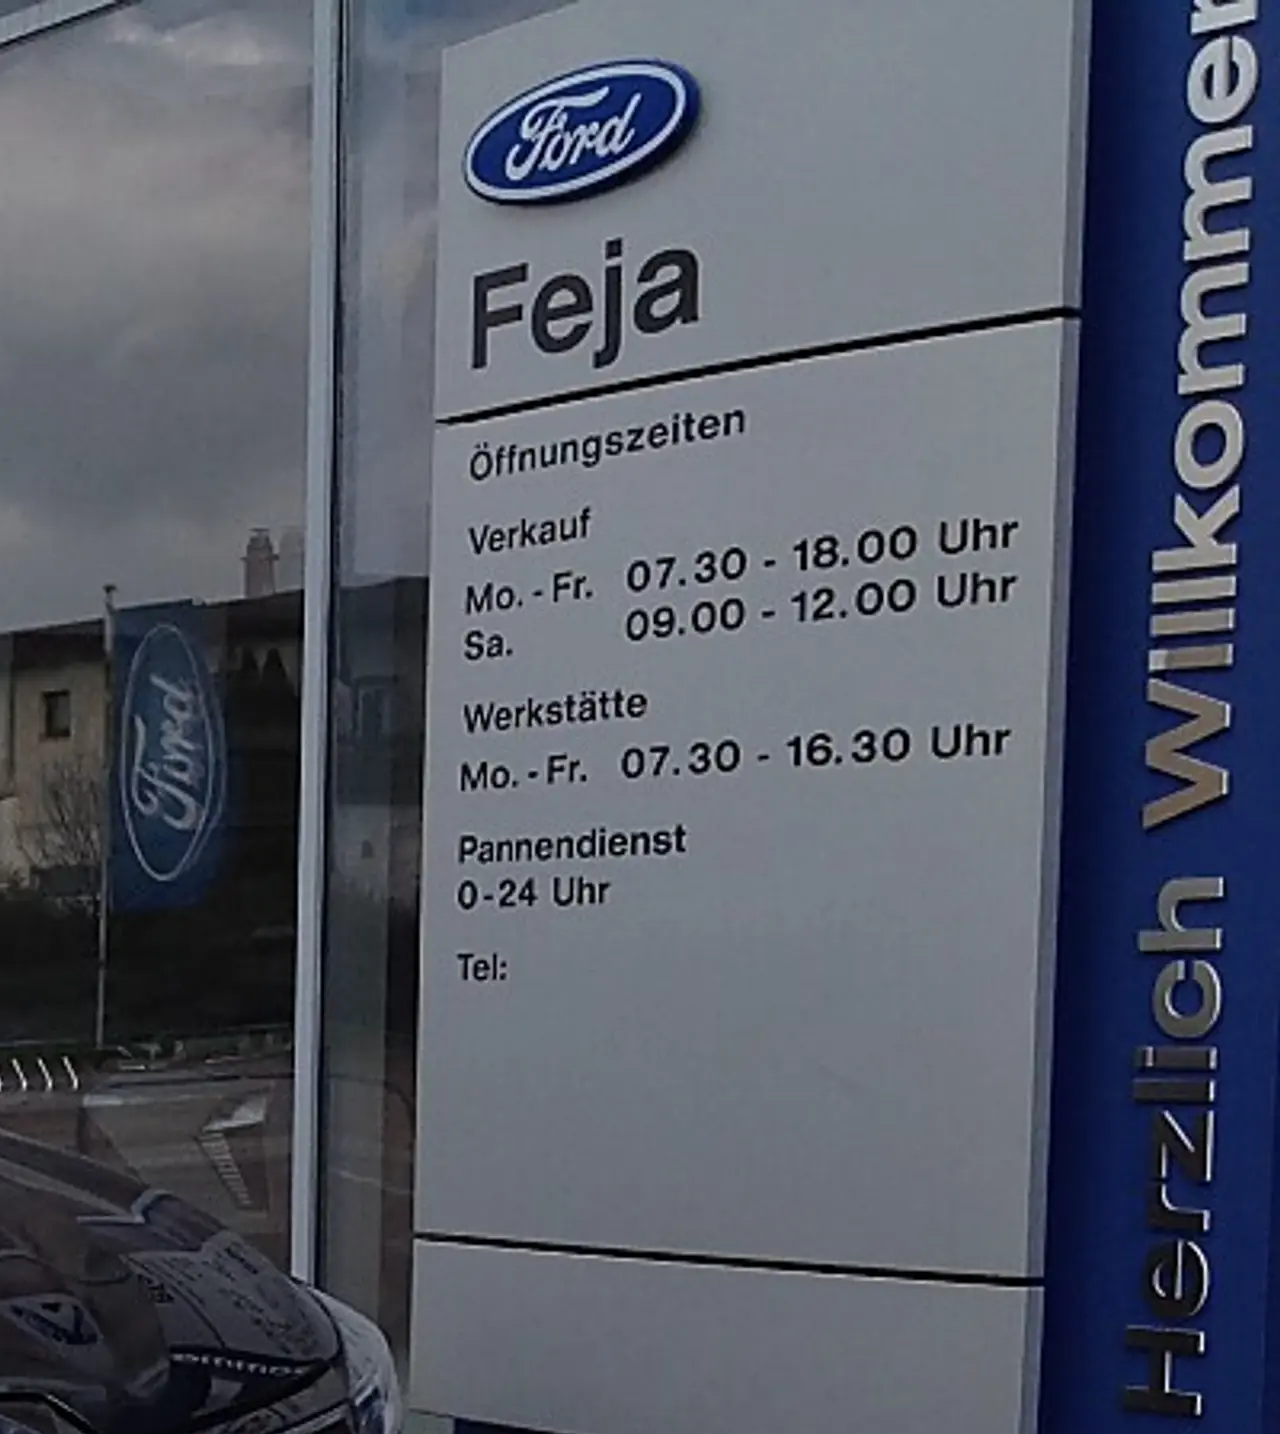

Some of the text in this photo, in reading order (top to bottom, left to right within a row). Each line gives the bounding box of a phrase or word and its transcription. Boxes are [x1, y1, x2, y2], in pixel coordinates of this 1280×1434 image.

[504, 85, 641, 182] Ford
[470, 237, 700, 369] Feja
[469, 409, 746, 481] Öffnungszeiten
[467, 506, 592, 555] Verkauf
[626, 546, 748, 593] 07.30
[792, 525, 918, 572] 18.00
[938, 518, 1020, 555] Uhr
[463, 630, 514, 661] Sa.
[625, 597, 746, 642] 09.00
[790, 578, 917, 623] 12.00
[937, 572, 1019, 609] Uhr
[463, 688, 648, 735] Werkstätte
[131, 671, 201, 830] Ford
[620, 739, 741, 779] 07.30
[786, 726, 911, 768] 16.30
[931, 723, 1013, 760] Uhr
[457, 823, 687, 865] Pannendienst
[457, 876, 612, 911] 0-24 Uhr
[456, 951, 508, 983] Tel:
[1122, 875, 1224, 1416] Herzlich
